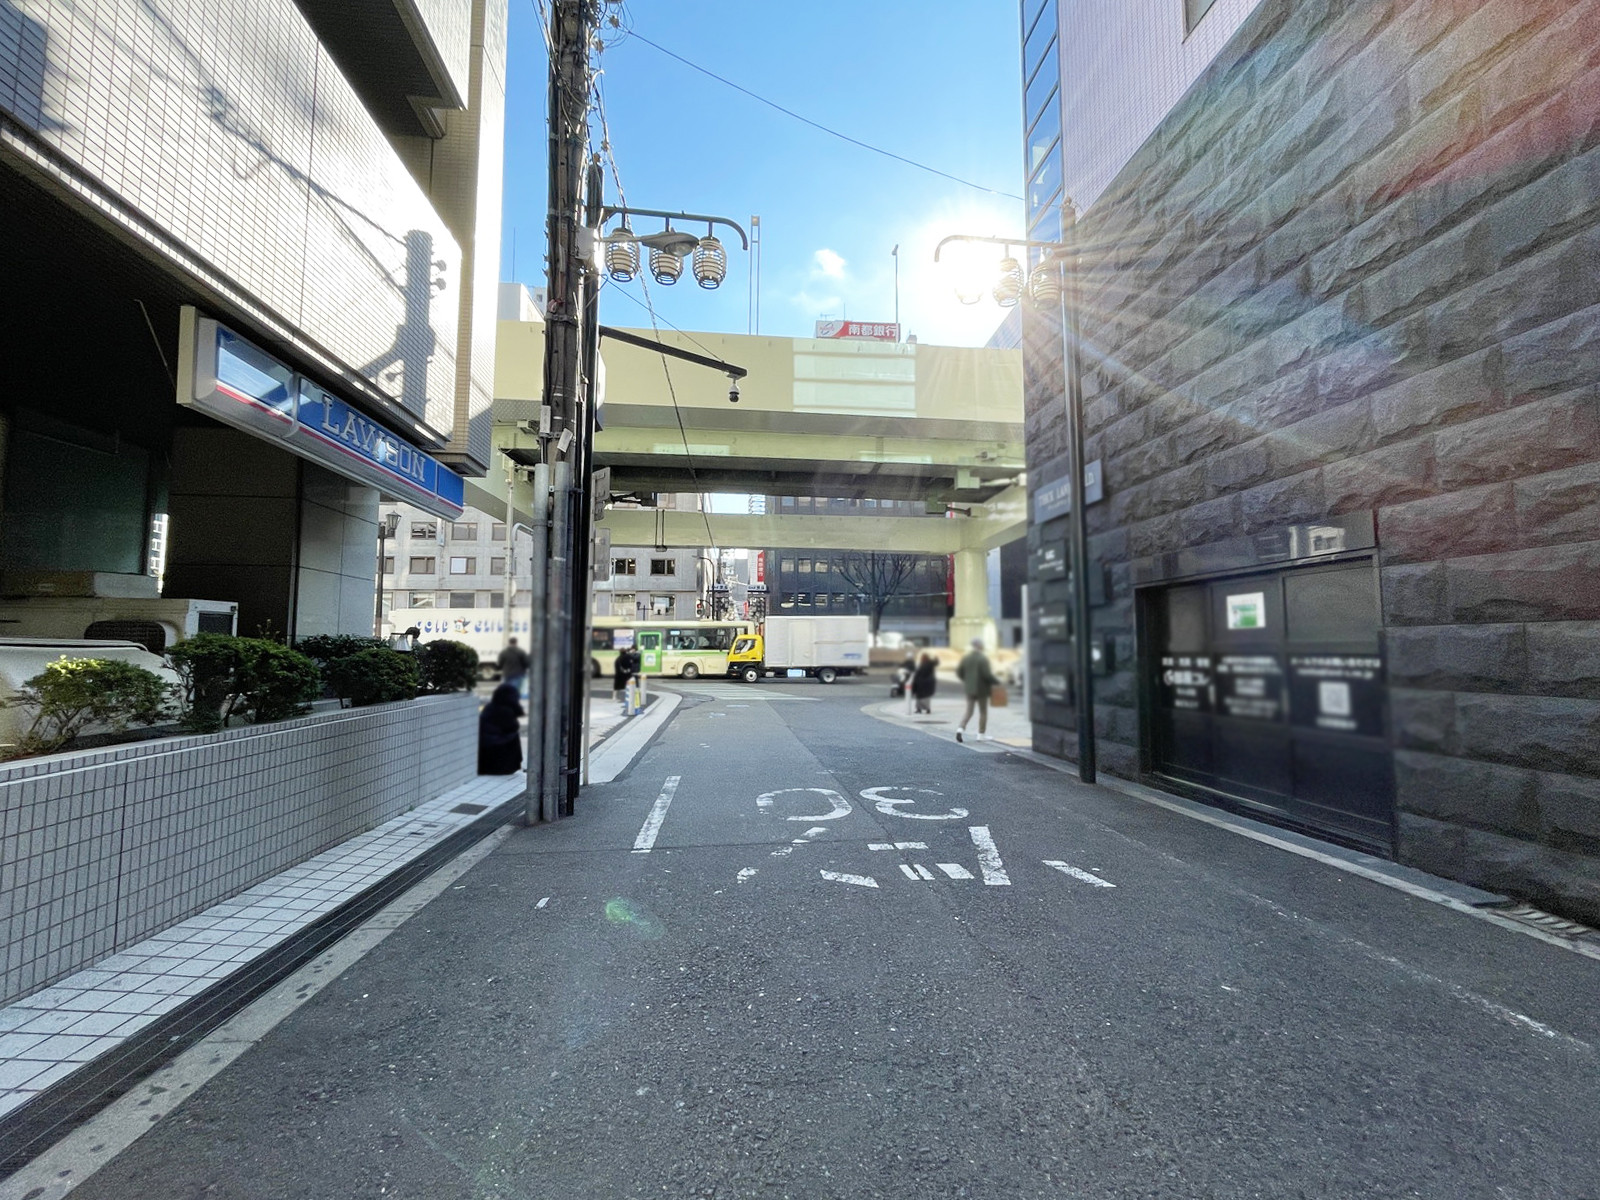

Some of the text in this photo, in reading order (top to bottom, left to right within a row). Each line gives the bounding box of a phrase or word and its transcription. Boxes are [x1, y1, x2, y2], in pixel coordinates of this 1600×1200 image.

[849, 325, 896, 337] 南都銀行
[321, 394, 426, 482] LAWSON
